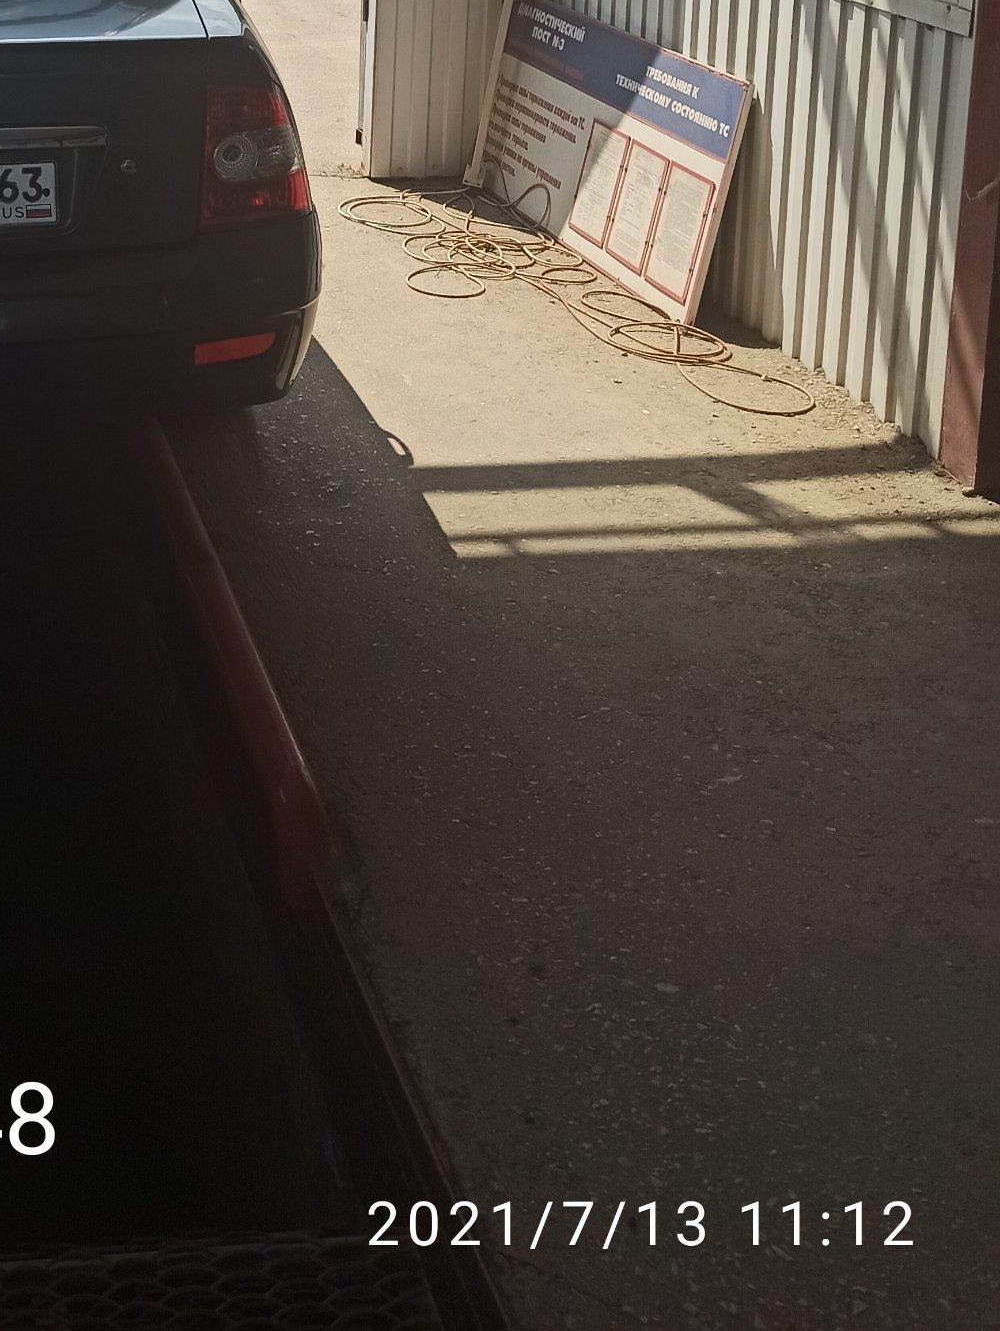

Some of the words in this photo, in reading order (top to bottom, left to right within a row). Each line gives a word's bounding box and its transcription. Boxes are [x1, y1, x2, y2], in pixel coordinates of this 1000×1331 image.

[517, 2, 586, 43] ДИАГНОСТИЧЕСКИЙ
[531, 26, 552, 44] ПОСТ
[645, 65, 693, 97] ТРЕБОВАНИЯ
[690, 86, 700, 99] К
[615, 73, 672, 108] ТЕХНИЧЕСКОМУ
[671, 100, 718, 132] СОСТОЯНИЮ
[718, 122, 730, 138] ТС
